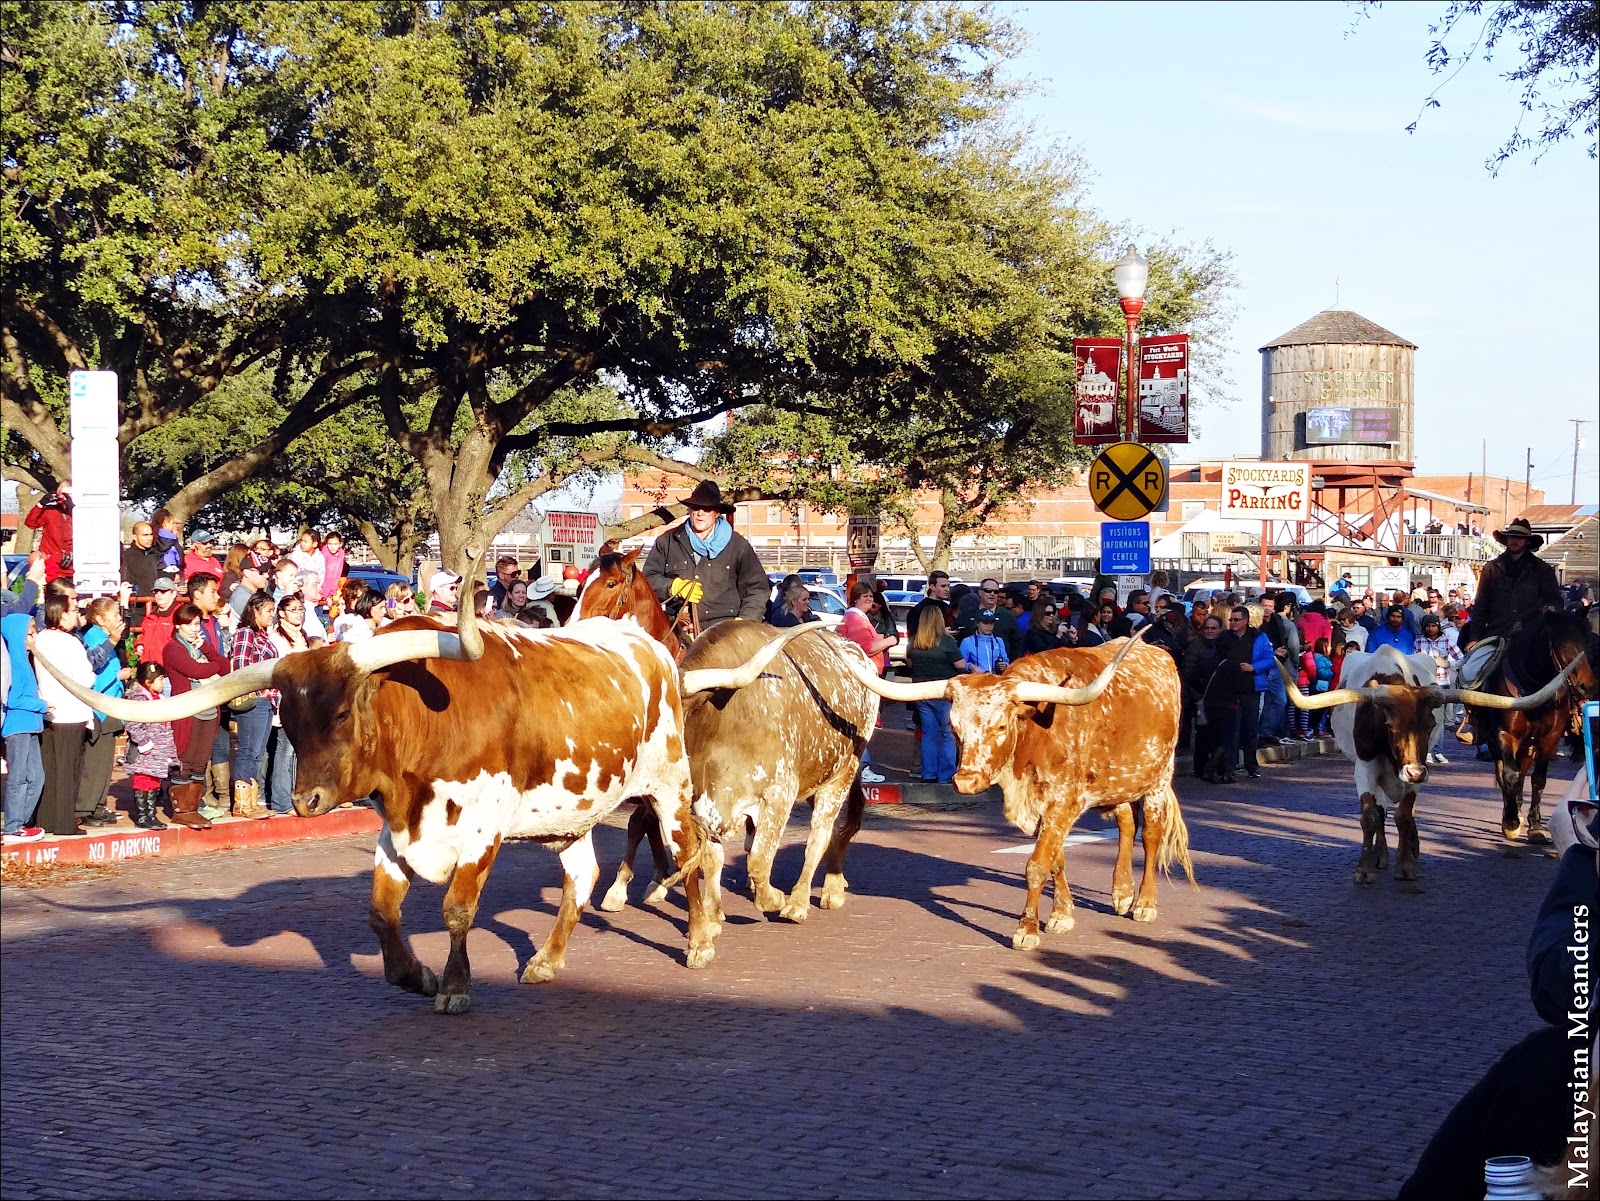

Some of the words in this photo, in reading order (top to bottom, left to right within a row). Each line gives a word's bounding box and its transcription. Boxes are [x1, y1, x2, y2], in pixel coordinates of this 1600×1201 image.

[1143, 352, 1184, 360] STOCKYARDS
[1303, 371, 1394, 383] STOCKYARDS
[1321, 388, 1381, 400] STATION
[1096, 471, 1110, 489] R
[1144, 471, 1159, 490] R
[1227, 467, 1304, 486] STOCKYARDS
[548, 513, 562, 526] FORT
[563, 514, 582, 528] WORTH
[582, 515, 597, 529] HERD
[552, 529, 575, 543] CATTLE
[576, 530, 595, 544] DRIVE
[1109, 528, 1141, 537] VISITORS
[1103, 540, 1148, 549] INFORMATION
[1112, 552, 1139, 561] CENTER
[861, 787, 880, 801] NG
[89, 842, 105, 860] NO
[111, 836, 161, 861] PARKING
